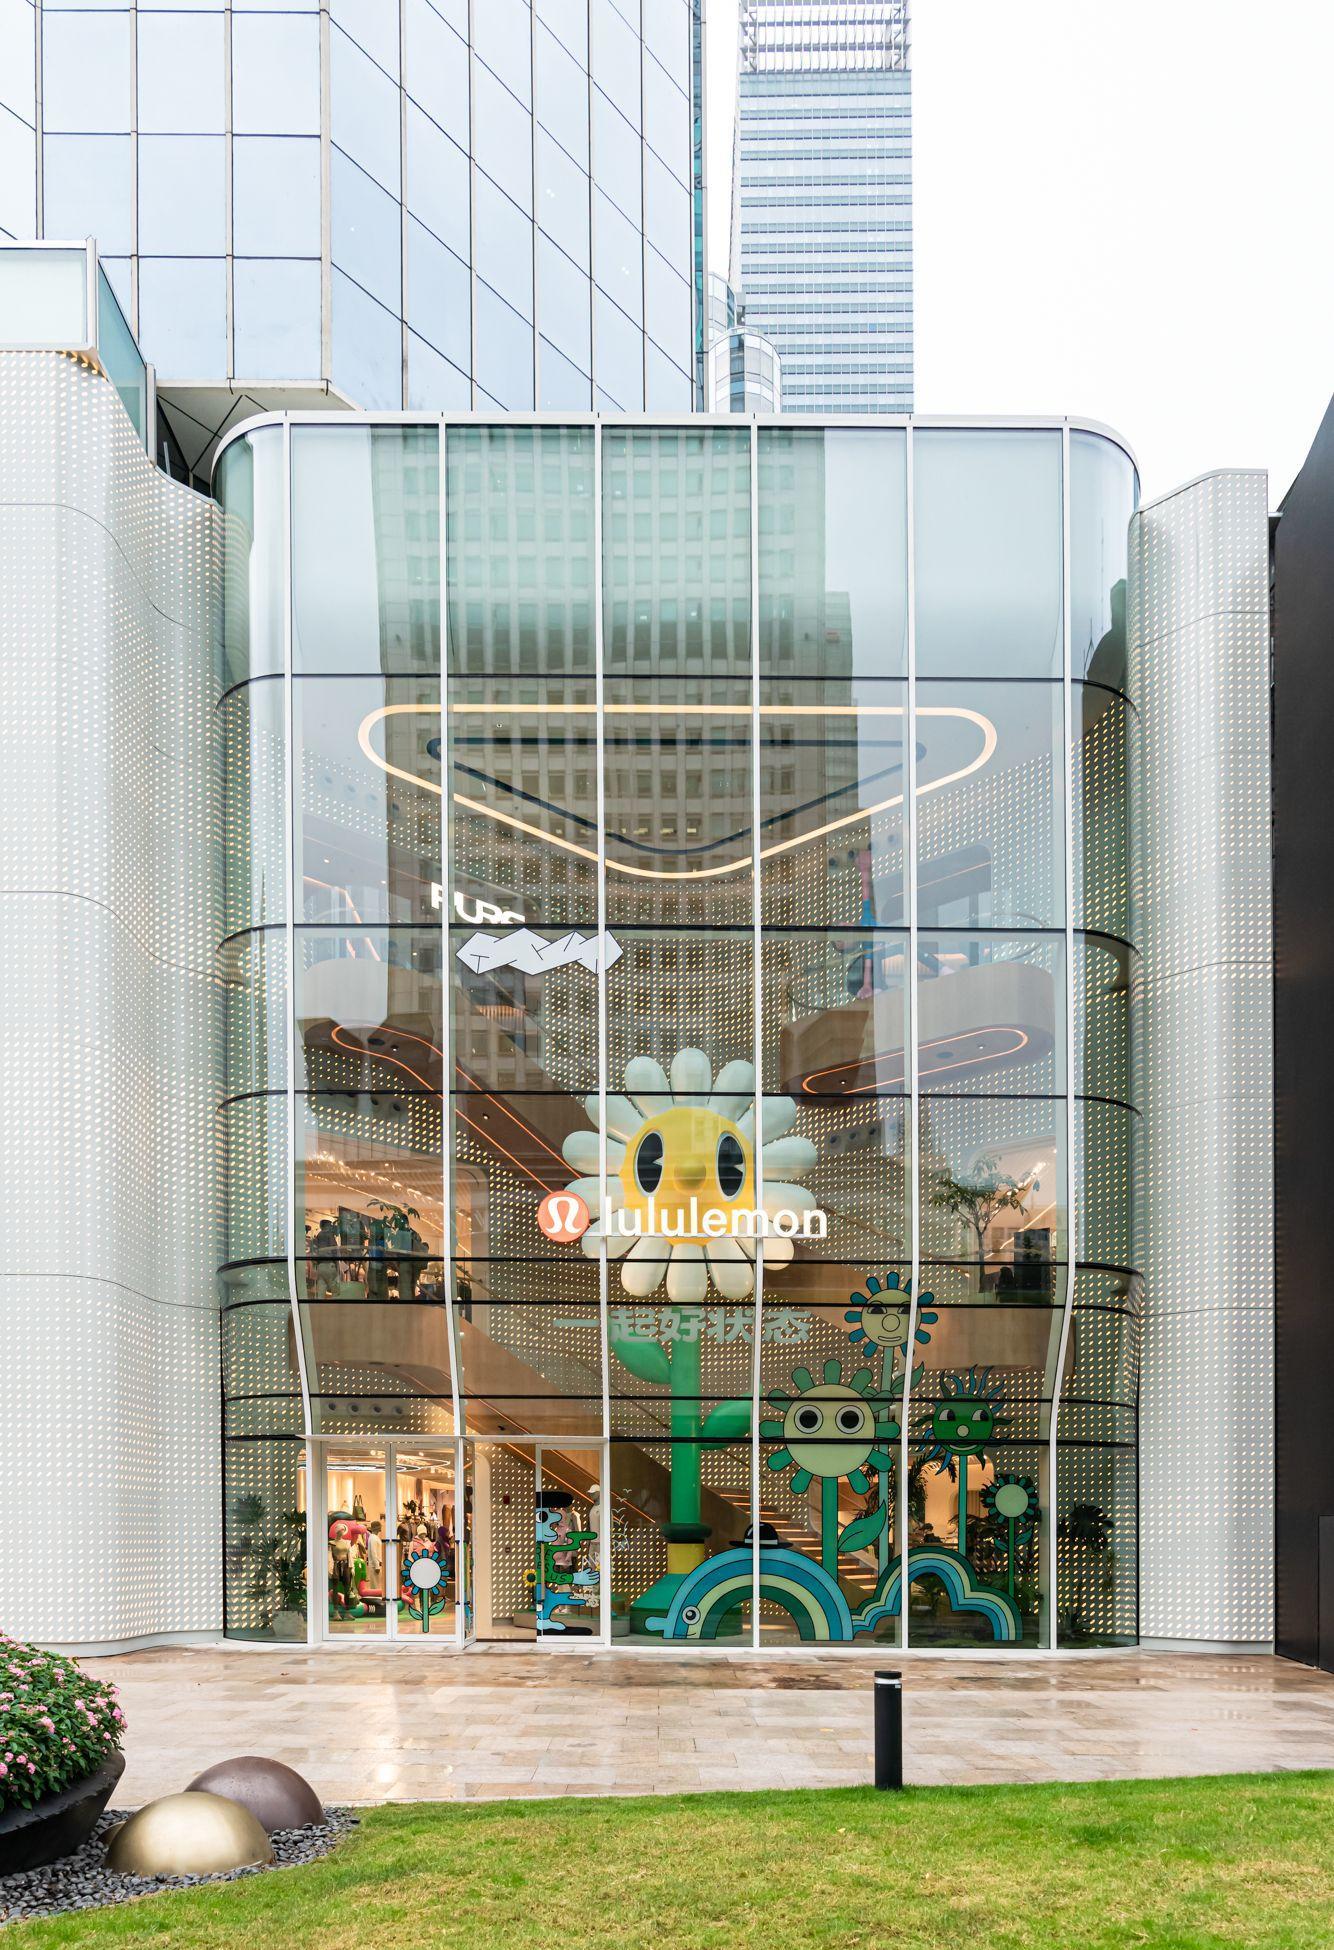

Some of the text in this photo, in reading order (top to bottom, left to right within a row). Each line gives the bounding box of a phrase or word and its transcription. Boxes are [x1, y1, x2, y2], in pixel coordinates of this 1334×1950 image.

[604, 1196, 828, 1238] lululemon
[552, 1308, 813, 1344] 一起好状态
